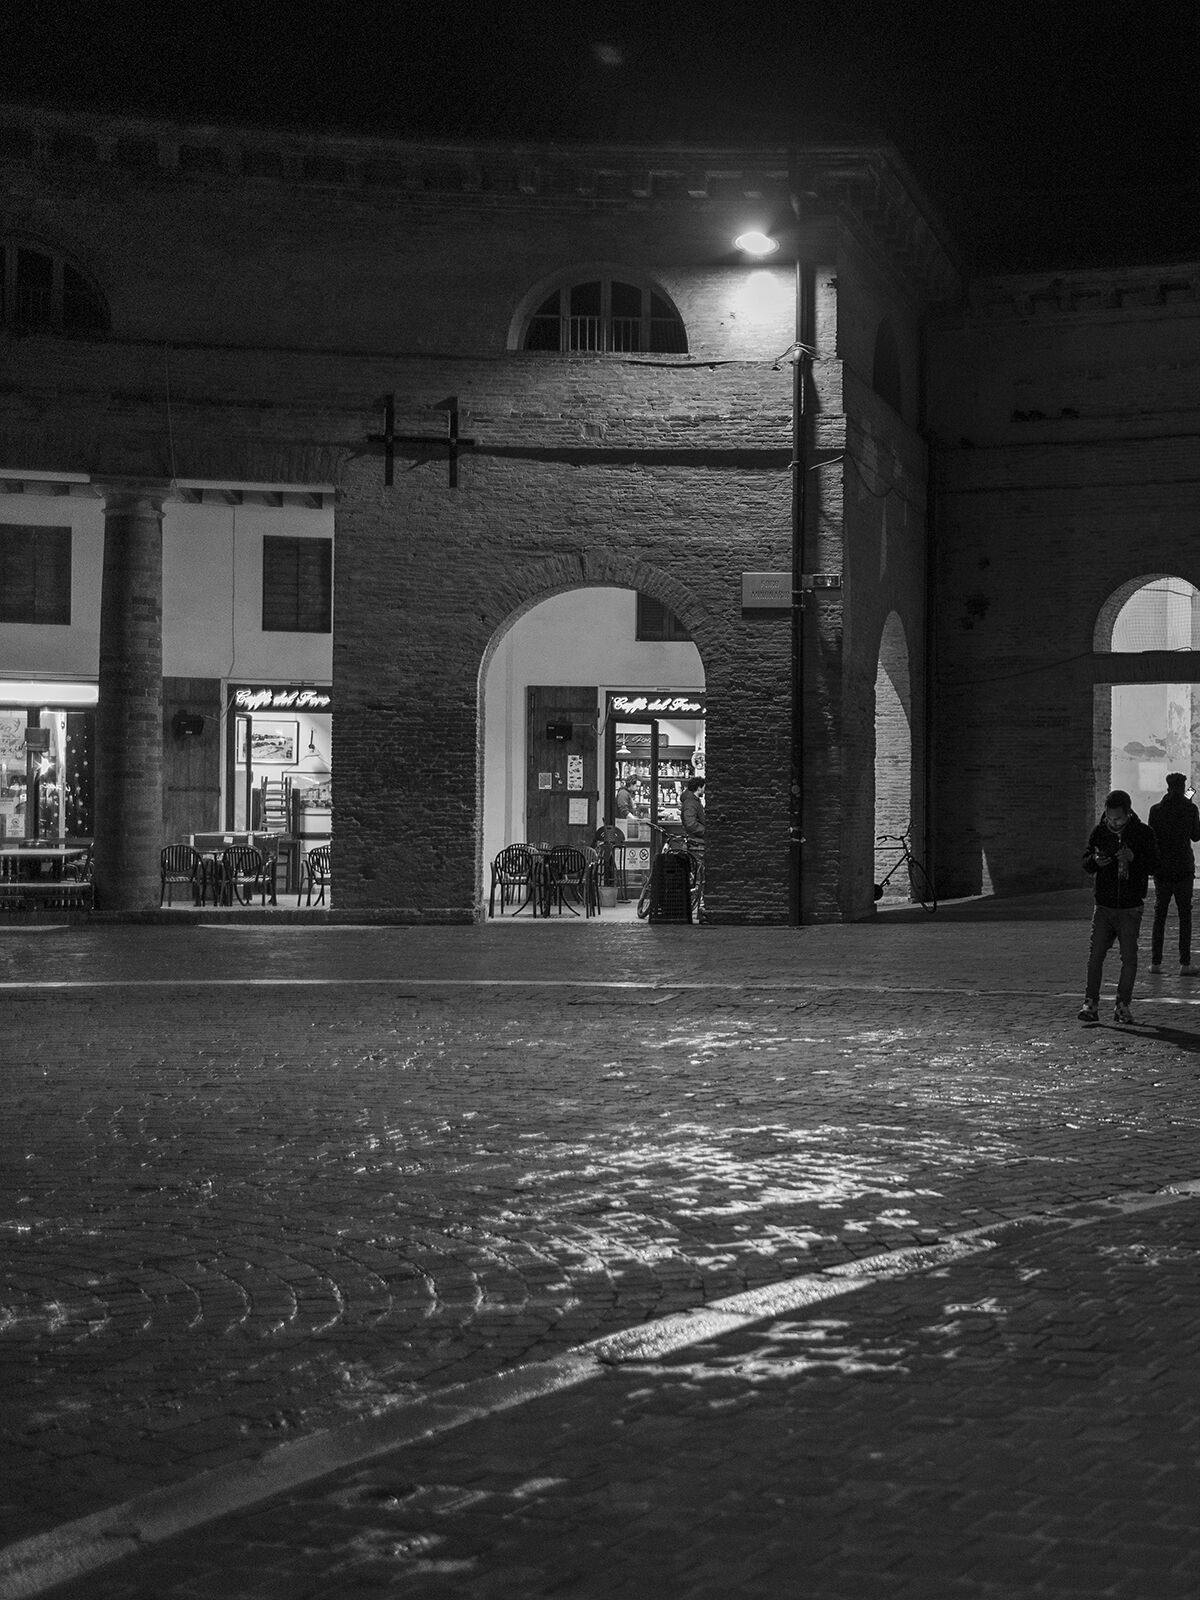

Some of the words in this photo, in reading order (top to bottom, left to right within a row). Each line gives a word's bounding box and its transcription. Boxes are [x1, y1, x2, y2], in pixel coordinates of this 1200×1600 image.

[273, 690, 299, 707] del
[648, 698, 672, 711] del
[669, 697, 701, 712] Foro
